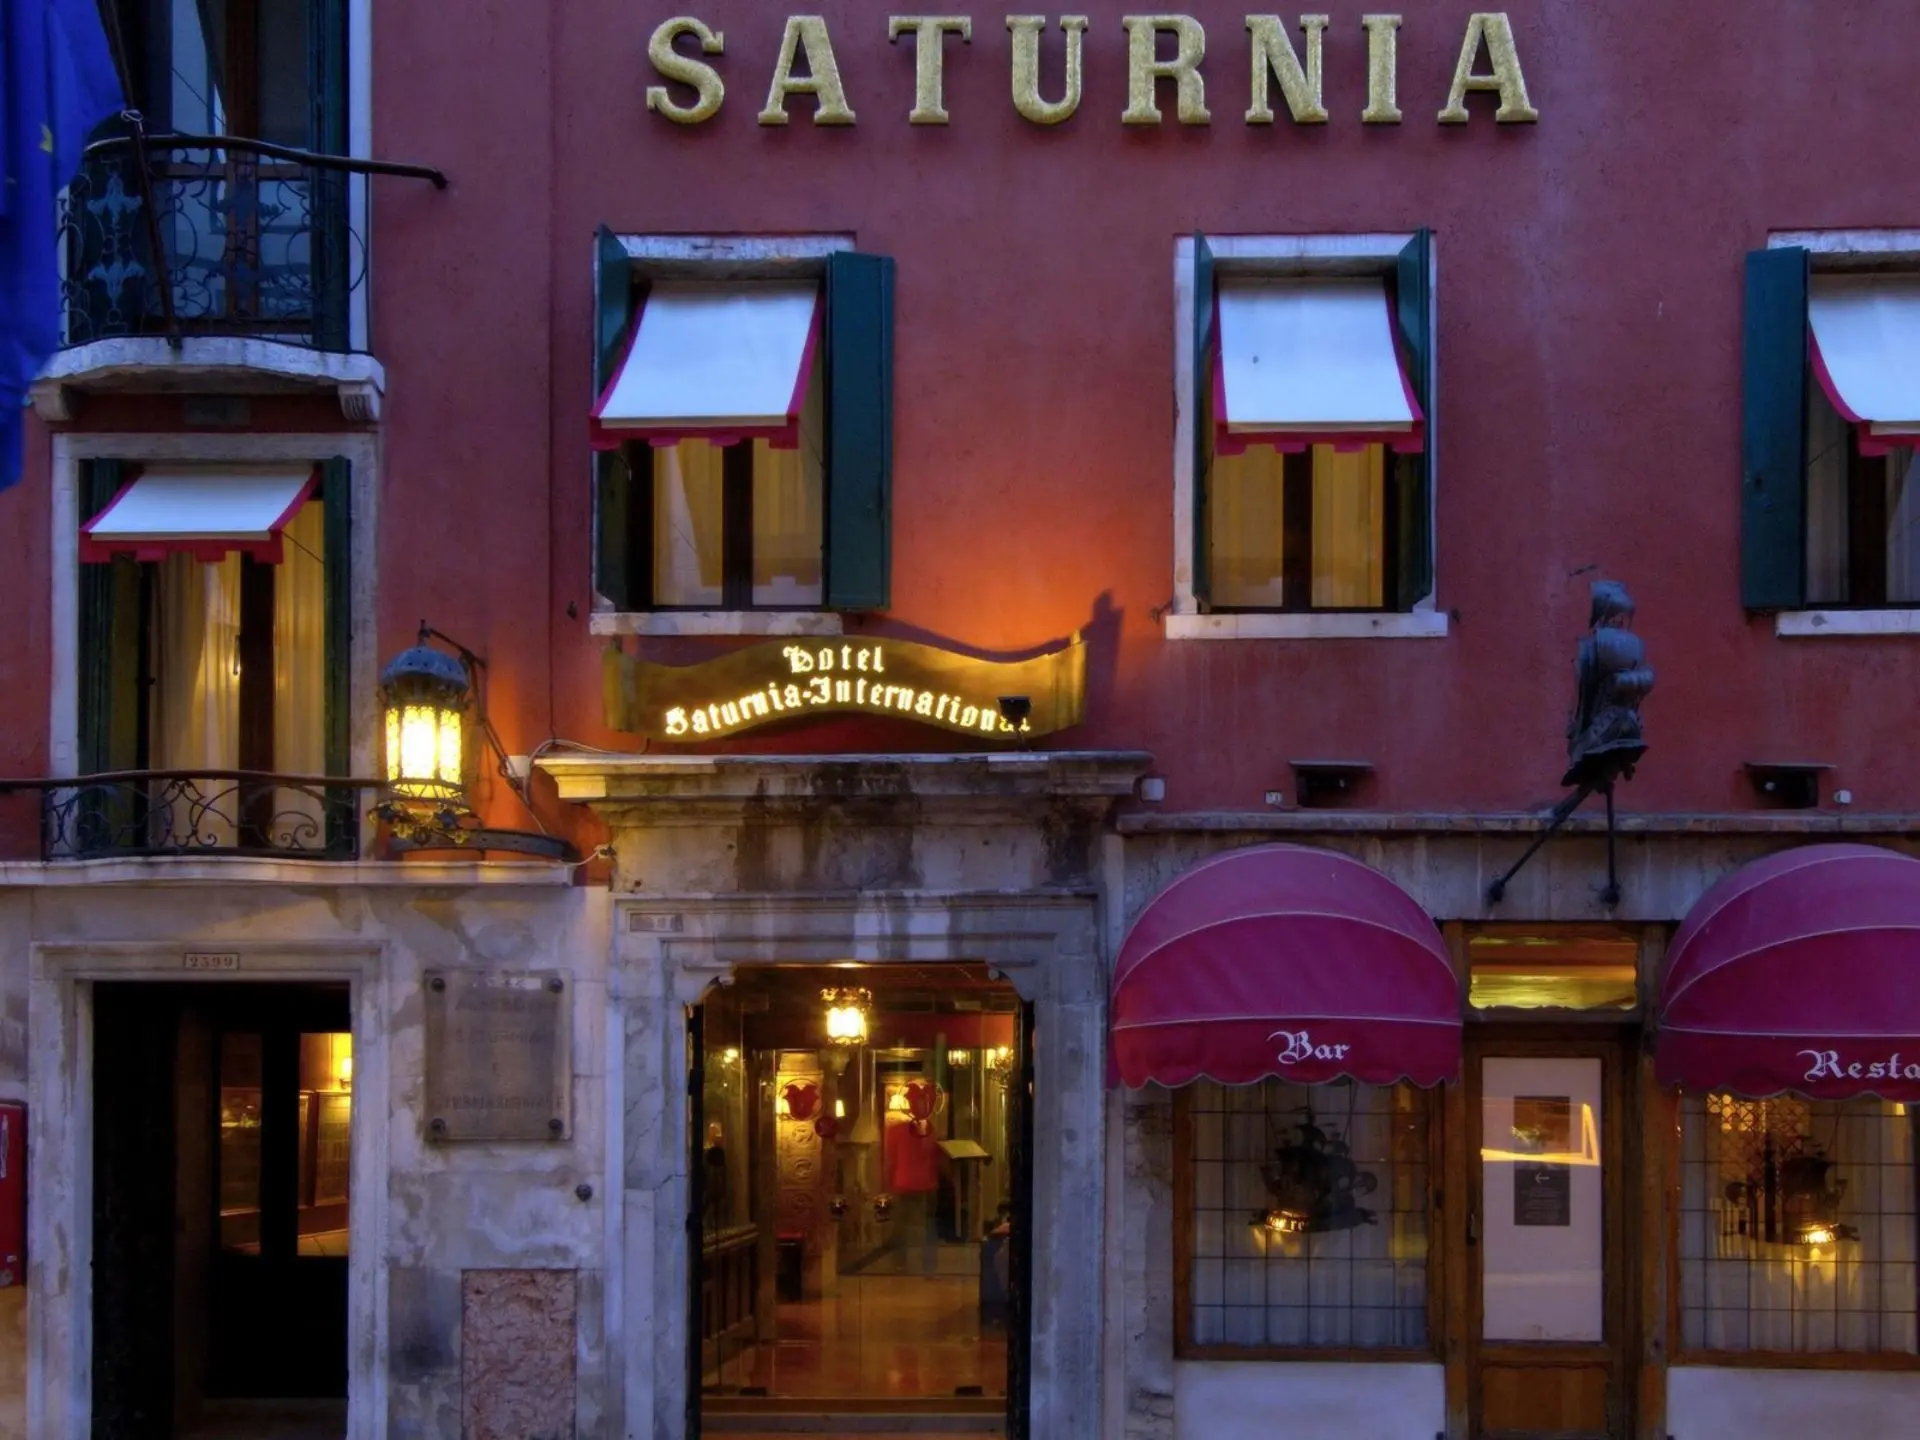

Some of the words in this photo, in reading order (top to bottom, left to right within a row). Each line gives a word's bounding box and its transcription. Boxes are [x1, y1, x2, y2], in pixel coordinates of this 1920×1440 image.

[646, 11, 1539, 126] SATURNIA
[782, 644, 885, 674] Hotel
[1266, 1030, 1350, 1064] Bar
